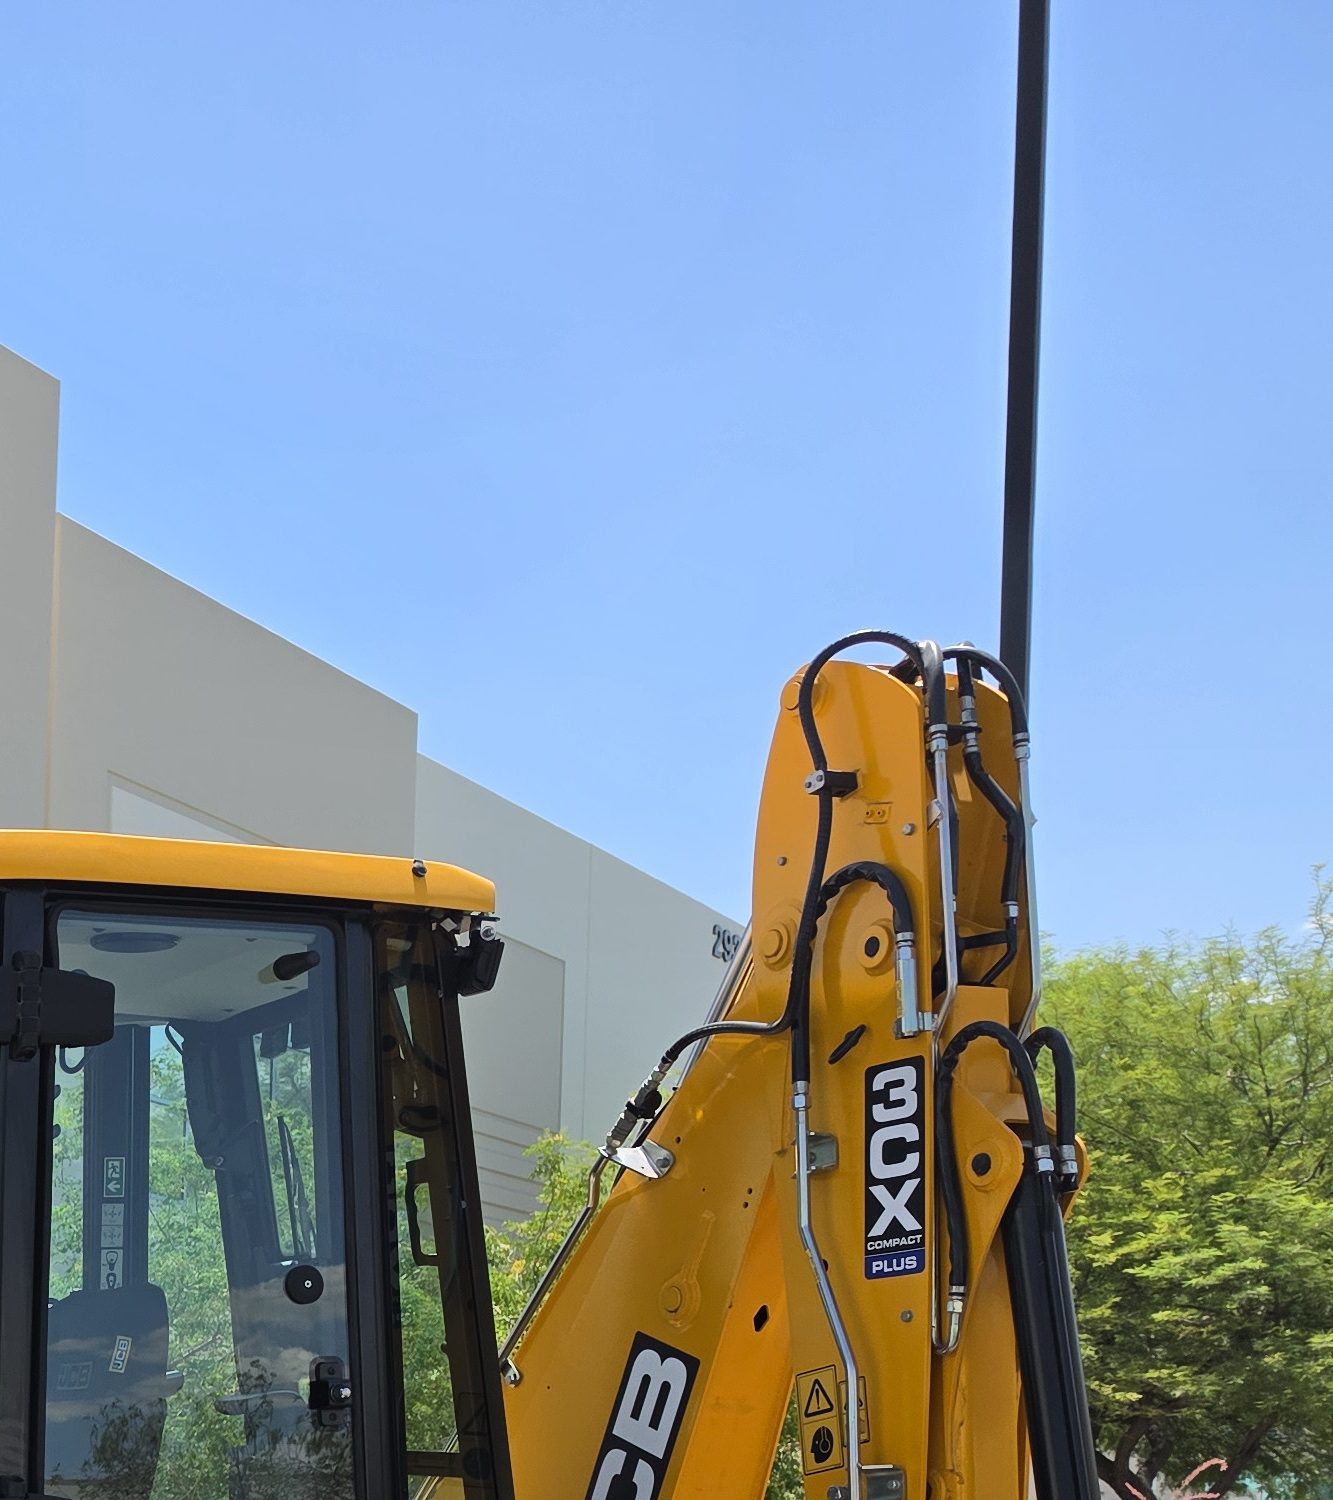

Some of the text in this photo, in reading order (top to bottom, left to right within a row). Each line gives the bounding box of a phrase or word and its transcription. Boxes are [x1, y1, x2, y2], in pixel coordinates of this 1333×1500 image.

[867, 1065, 923, 1238] 3CX
[866, 1234, 923, 1251] COMPACT
[871, 1255, 918, 1275] PLUS
[113, 1339, 129, 1371] JCB
